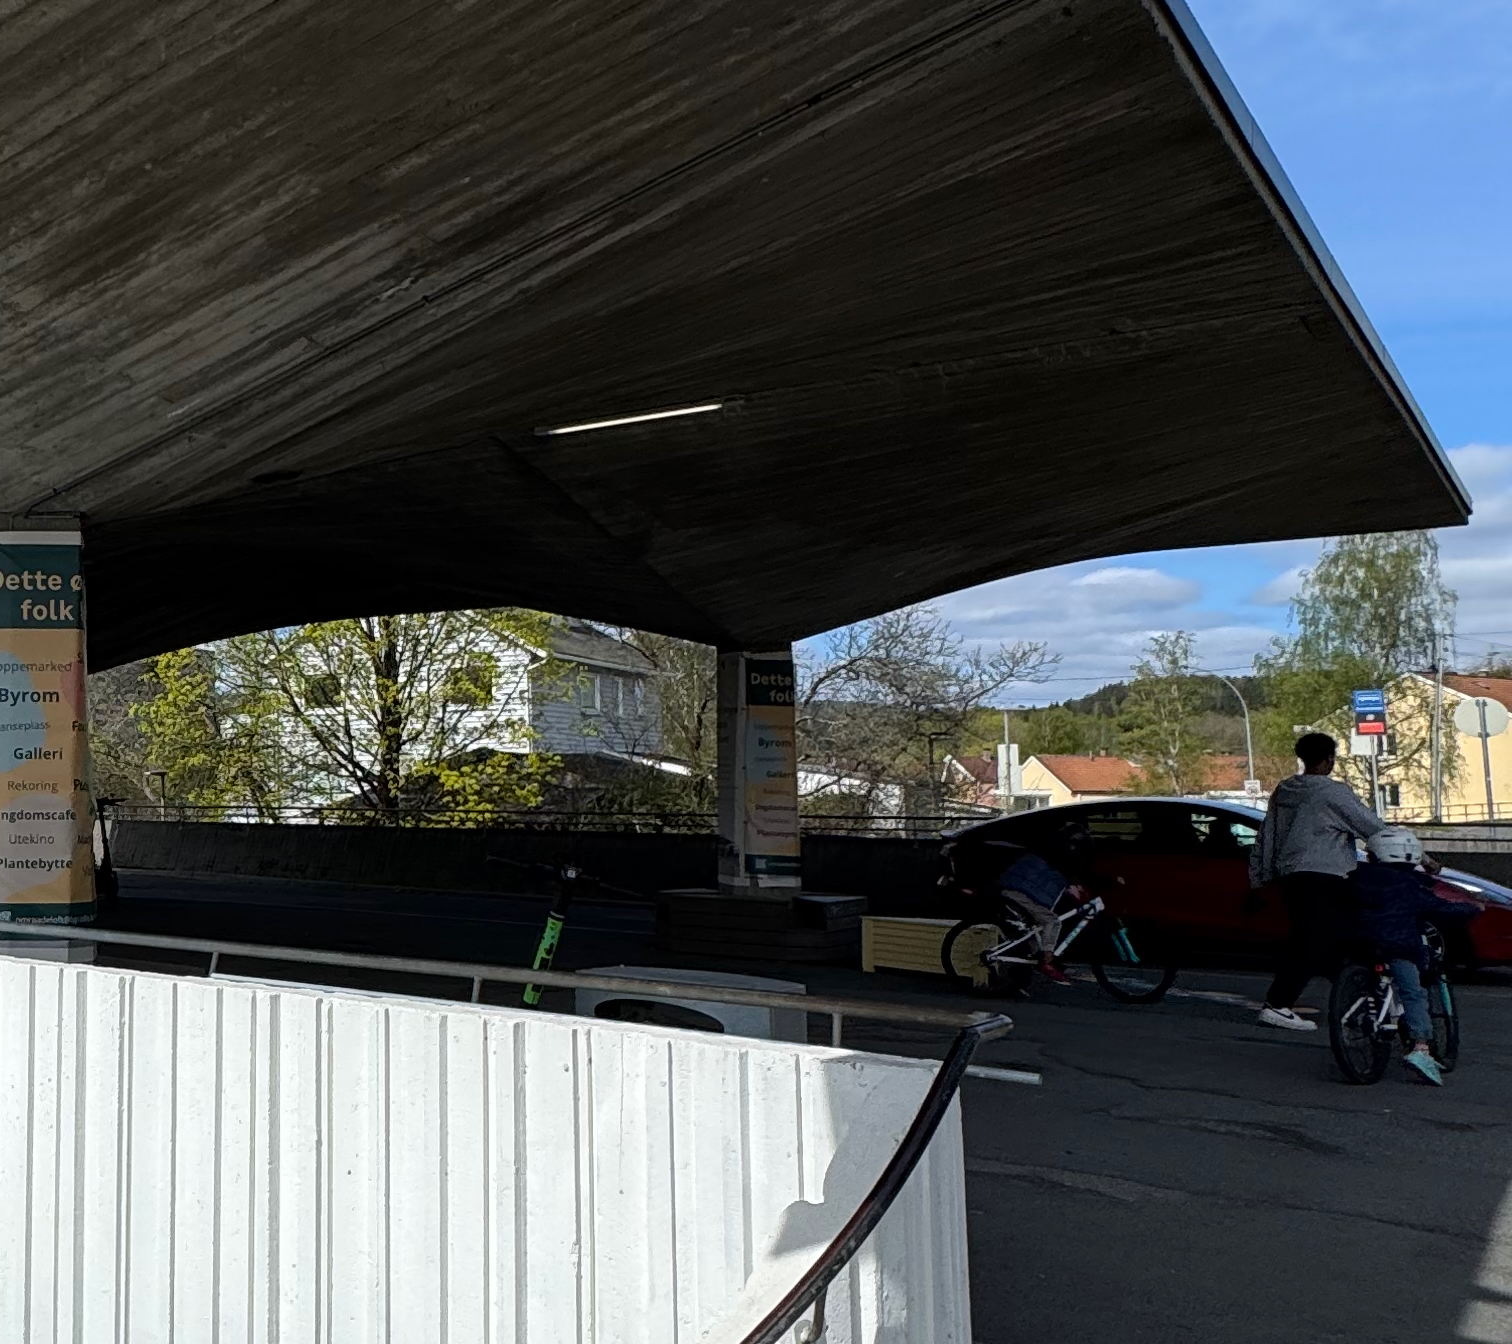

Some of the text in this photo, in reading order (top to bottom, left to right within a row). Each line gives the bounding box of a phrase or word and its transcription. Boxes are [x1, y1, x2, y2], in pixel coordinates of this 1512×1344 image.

[20, 600, 74, 621] folk
[750, 672, 792, 686] Dette
[758, 738, 792, 748] Byrom
[14, 747, 62, 759] Galleri
[8, 780, 59, 793] Rekoring
[9, 834, 54, 844] Utekino
